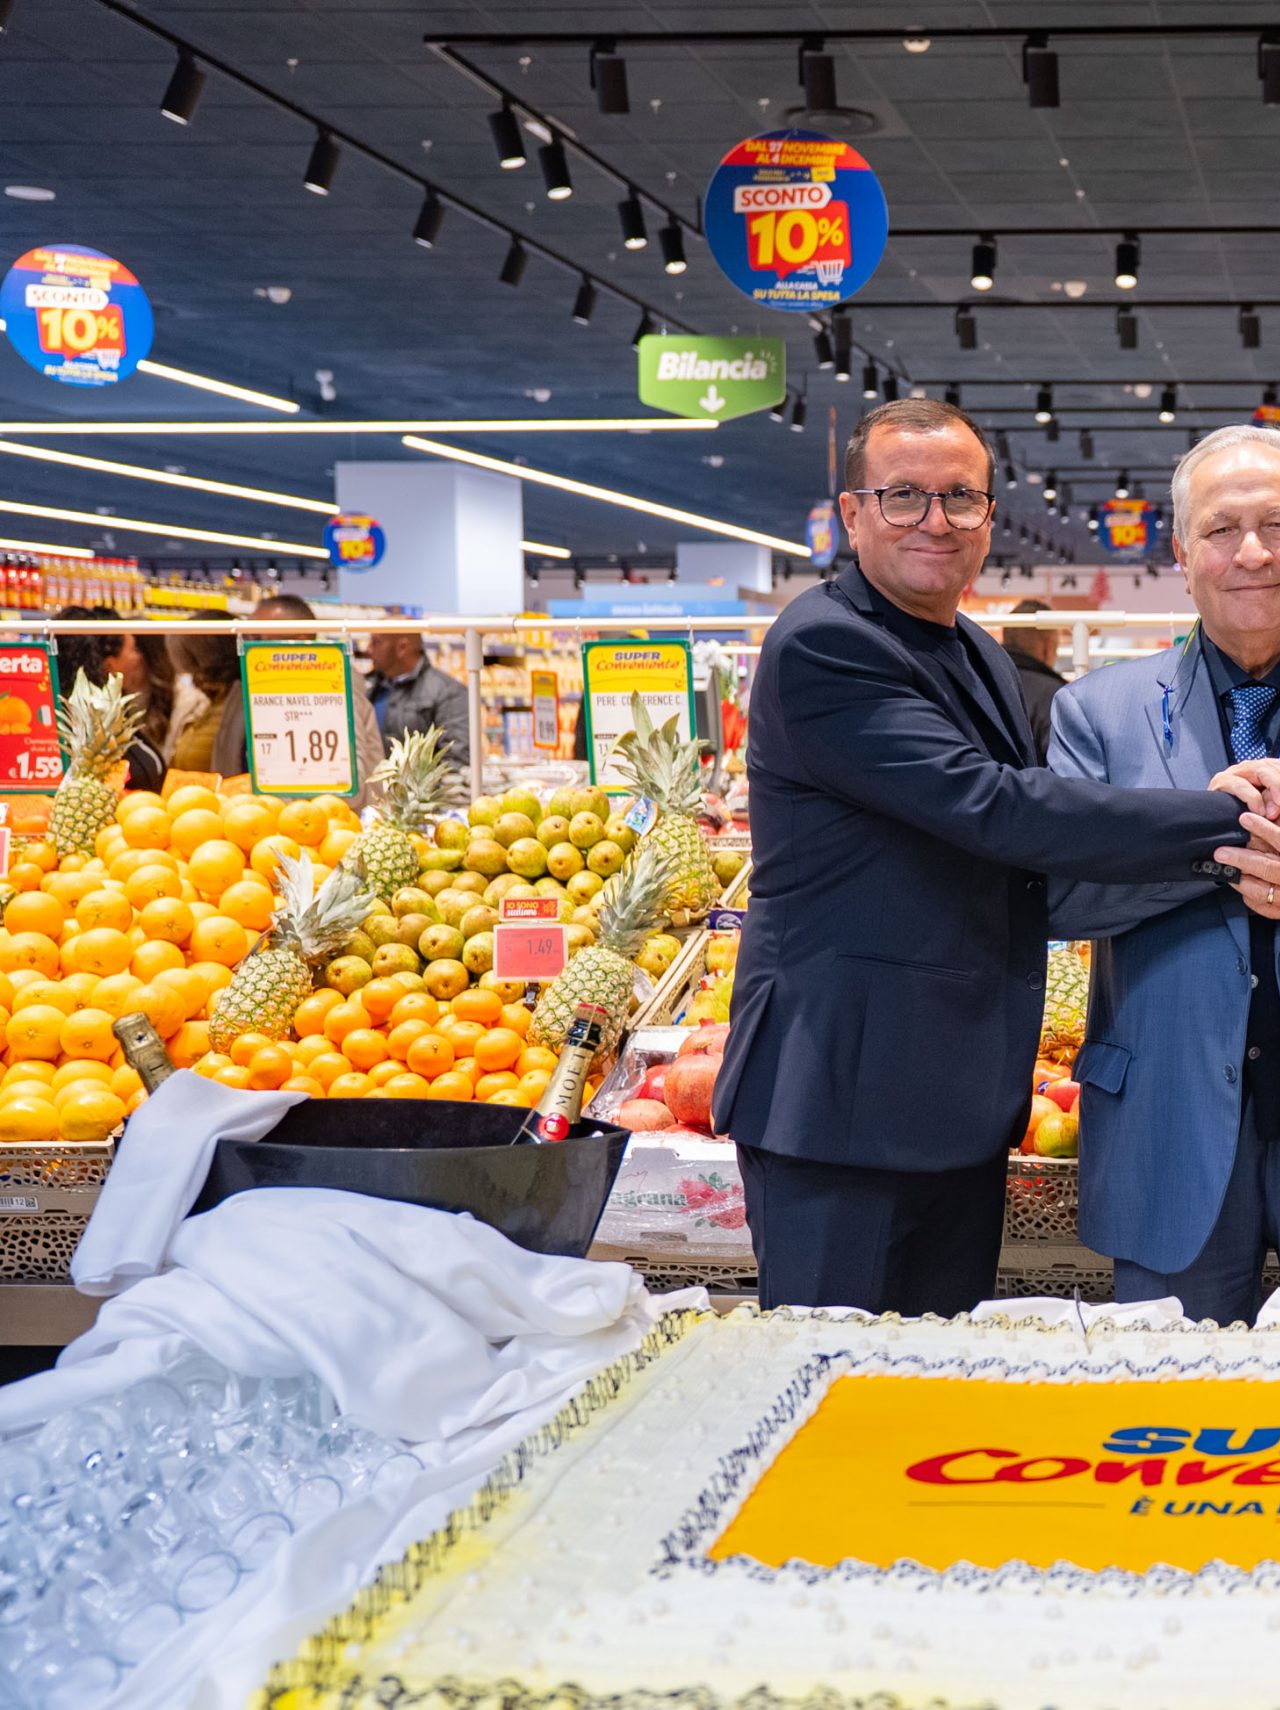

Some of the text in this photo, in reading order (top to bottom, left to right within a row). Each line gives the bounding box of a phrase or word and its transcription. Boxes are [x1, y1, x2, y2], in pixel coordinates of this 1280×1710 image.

[741, 186, 824, 207] SCONTO
[751, 209, 844, 265] 10%
[32, 289, 101, 305] SCONTO
[41, 308, 119, 350] 10%
[657, 351, 767, 380] Bilancia
[0, 654, 43, 673] erta
[272, 653, 317, 662] SUPER
[614, 652, 661, 660] SUPER
[596, 660, 680, 671] Conveniente
[253, 695, 343, 706] ARANCE NAVEL DOPPIO
[596, 695, 616, 706] PERE
[261, 730, 338, 764] 17 1,89
[516, 901, 539, 909] SONO
[1129, 1494, 1153, 1517] È
[1163, 1499, 1265, 1516] UNA
